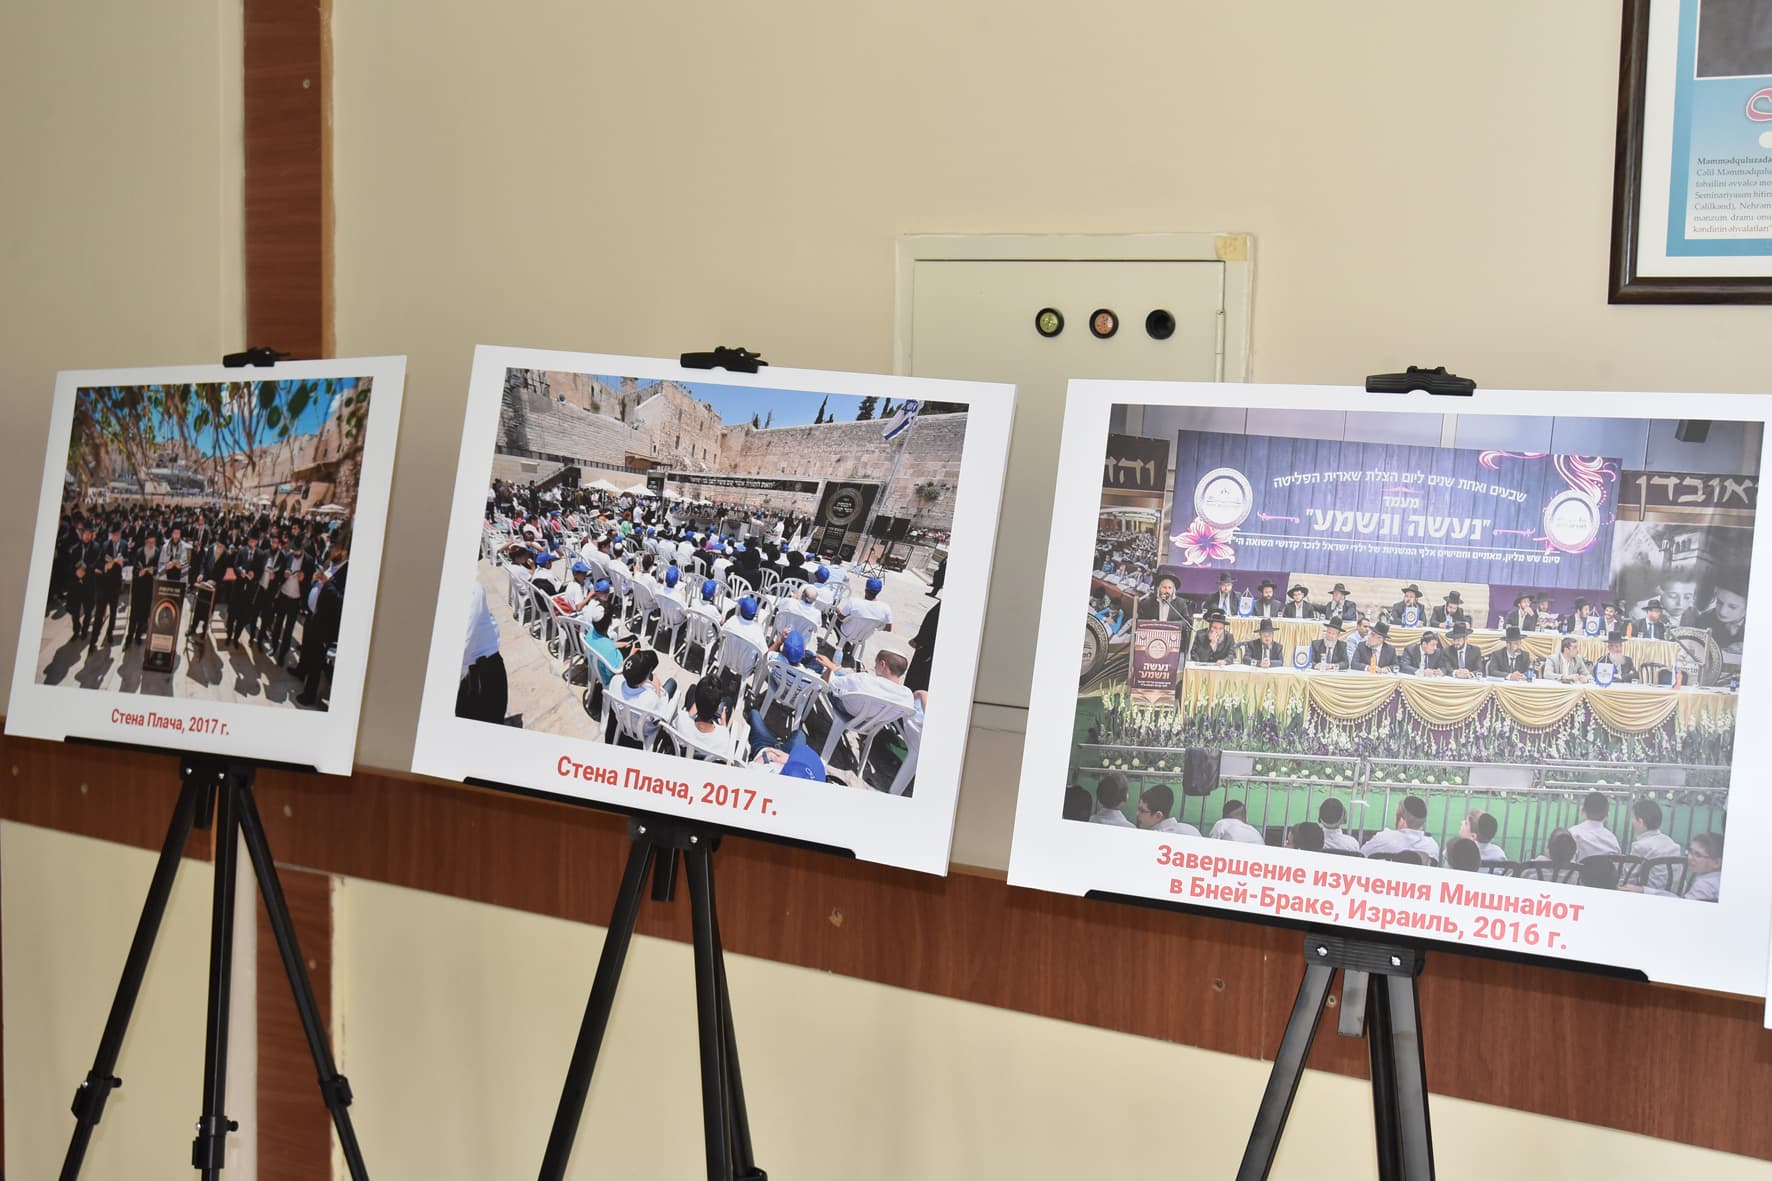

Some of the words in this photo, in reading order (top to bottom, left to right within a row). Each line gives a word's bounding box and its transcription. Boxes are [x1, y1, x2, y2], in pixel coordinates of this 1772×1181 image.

[1273, 472, 1320, 488] הפליטה
[1323, 471, 1362, 482] שארית
[1365, 467, 1398, 482] הצלת
[1402, 470, 1425, 484] ליום
[1428, 475, 1455, 488] שנים
[1457, 479, 1487, 494] ואחת
[1490, 485, 1527, 502] שבעים
[1383, 496, 1420, 509] מעמד
[111, 708, 145, 726] Стена
[147, 712, 185, 734] Плача,
[188, 716, 219, 735] 2017
[220, 722, 230, 736] г.
[557, 755, 618, 786] Стена
[624, 767, 694, 805] Плача,
[701, 782, 758, 811] 2017
[761, 797, 778, 816] г.
[1156, 843, 1307, 887] Завершение
[1312, 868, 1432, 901] изучения
[1439, 881, 1585, 922] Мишнайот
[1169, 879, 1183, 895] в
[1190, 877, 1341, 922] Бней-Браке,
[1347, 898, 1465, 940] Израиль,
[1472, 916, 1540, 947] 2016
[1548, 929, 1568, 950] г.
